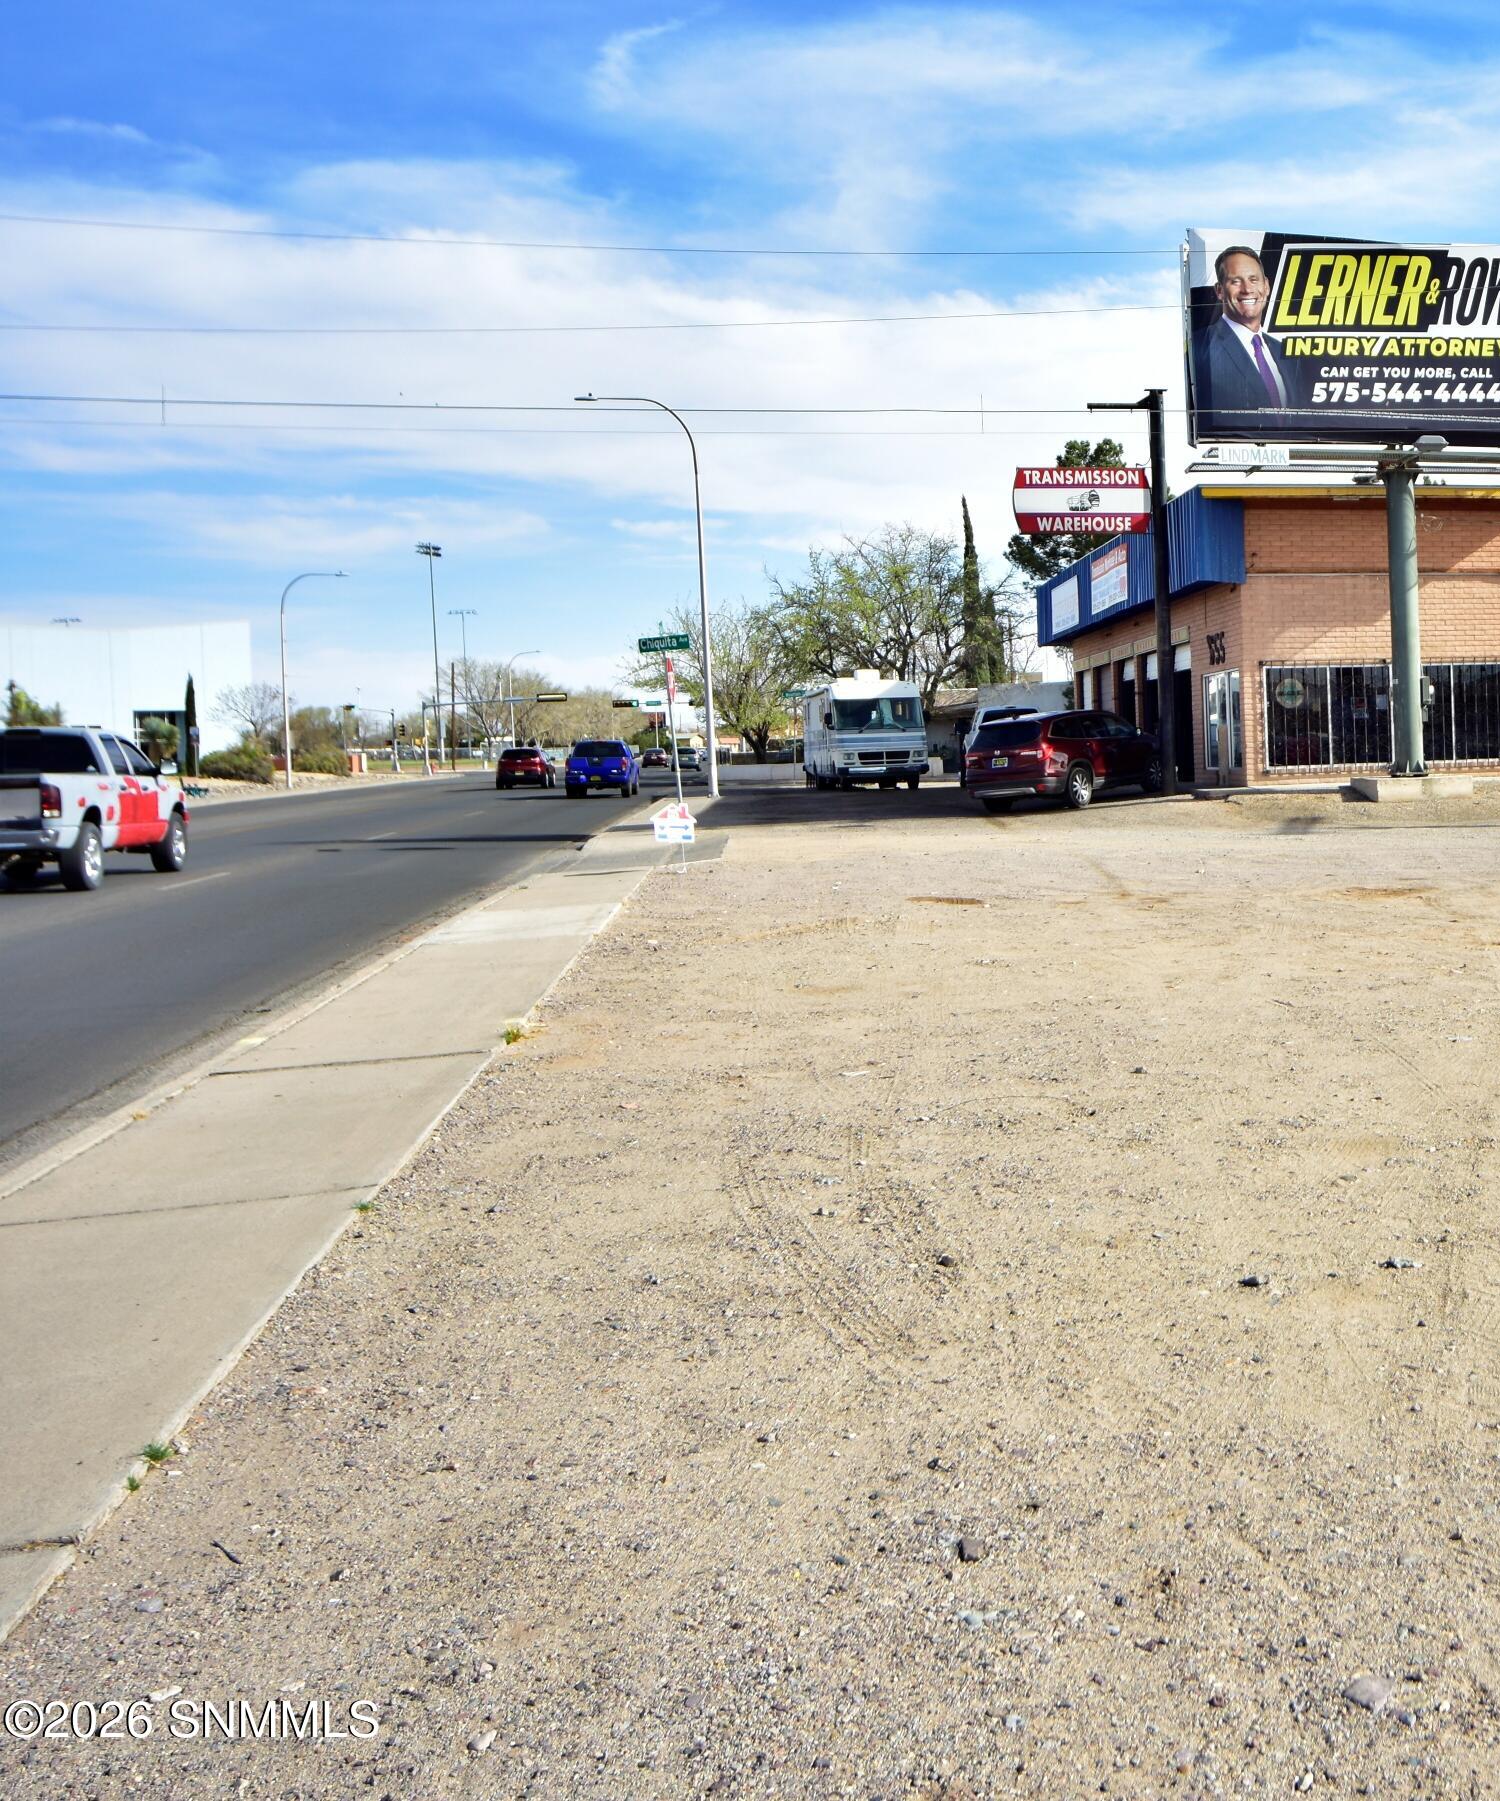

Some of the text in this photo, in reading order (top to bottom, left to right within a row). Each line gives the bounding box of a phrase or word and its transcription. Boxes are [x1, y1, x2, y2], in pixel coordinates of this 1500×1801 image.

[1275, 254, 1432, 326] LERNER
[1425, 278, 1441, 304] &
[1284, 337, 1377, 357] INJURY
[1319, 366, 1494, 380] CAN GET YOU MORE, CALL
[1220, 448, 1288, 464] LINDMARK
[1023, 470, 1140, 485] TRANSMISSION
[1036, 516, 1132, 532] WAREHOUSE
[640, 636, 678, 650] Chiquita
